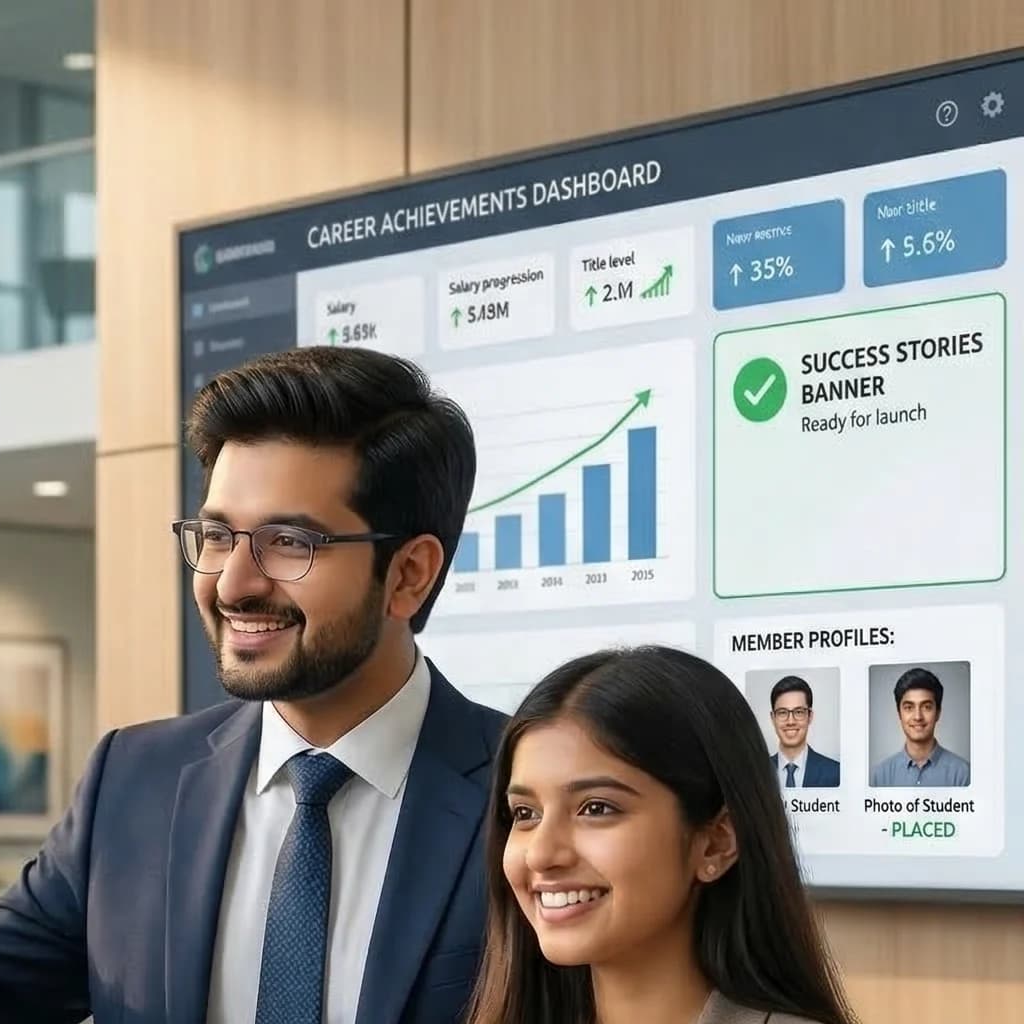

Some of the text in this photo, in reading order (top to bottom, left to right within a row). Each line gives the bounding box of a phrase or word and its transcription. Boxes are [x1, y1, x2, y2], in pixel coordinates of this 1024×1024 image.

[307, 161, 661, 248] CAREER ACHIEVEMENTS DASHBOARD
[903, 229, 955, 257] 5.6%
[581, 251, 635, 271] Title level
[750, 256, 794, 281] 35%
[449, 280, 480, 295] Salary
[801, 332, 983, 375] SUCCESS STORIES
[802, 375, 885, 405] BANNER
[801, 403, 927, 434] Ready for launch
[732, 627, 895, 652] MEMBER PROFILES:
[791, 798, 840, 813] Student
[864, 798, 975, 813] Photo of Student
[892, 821, 956, 838] PLACED
